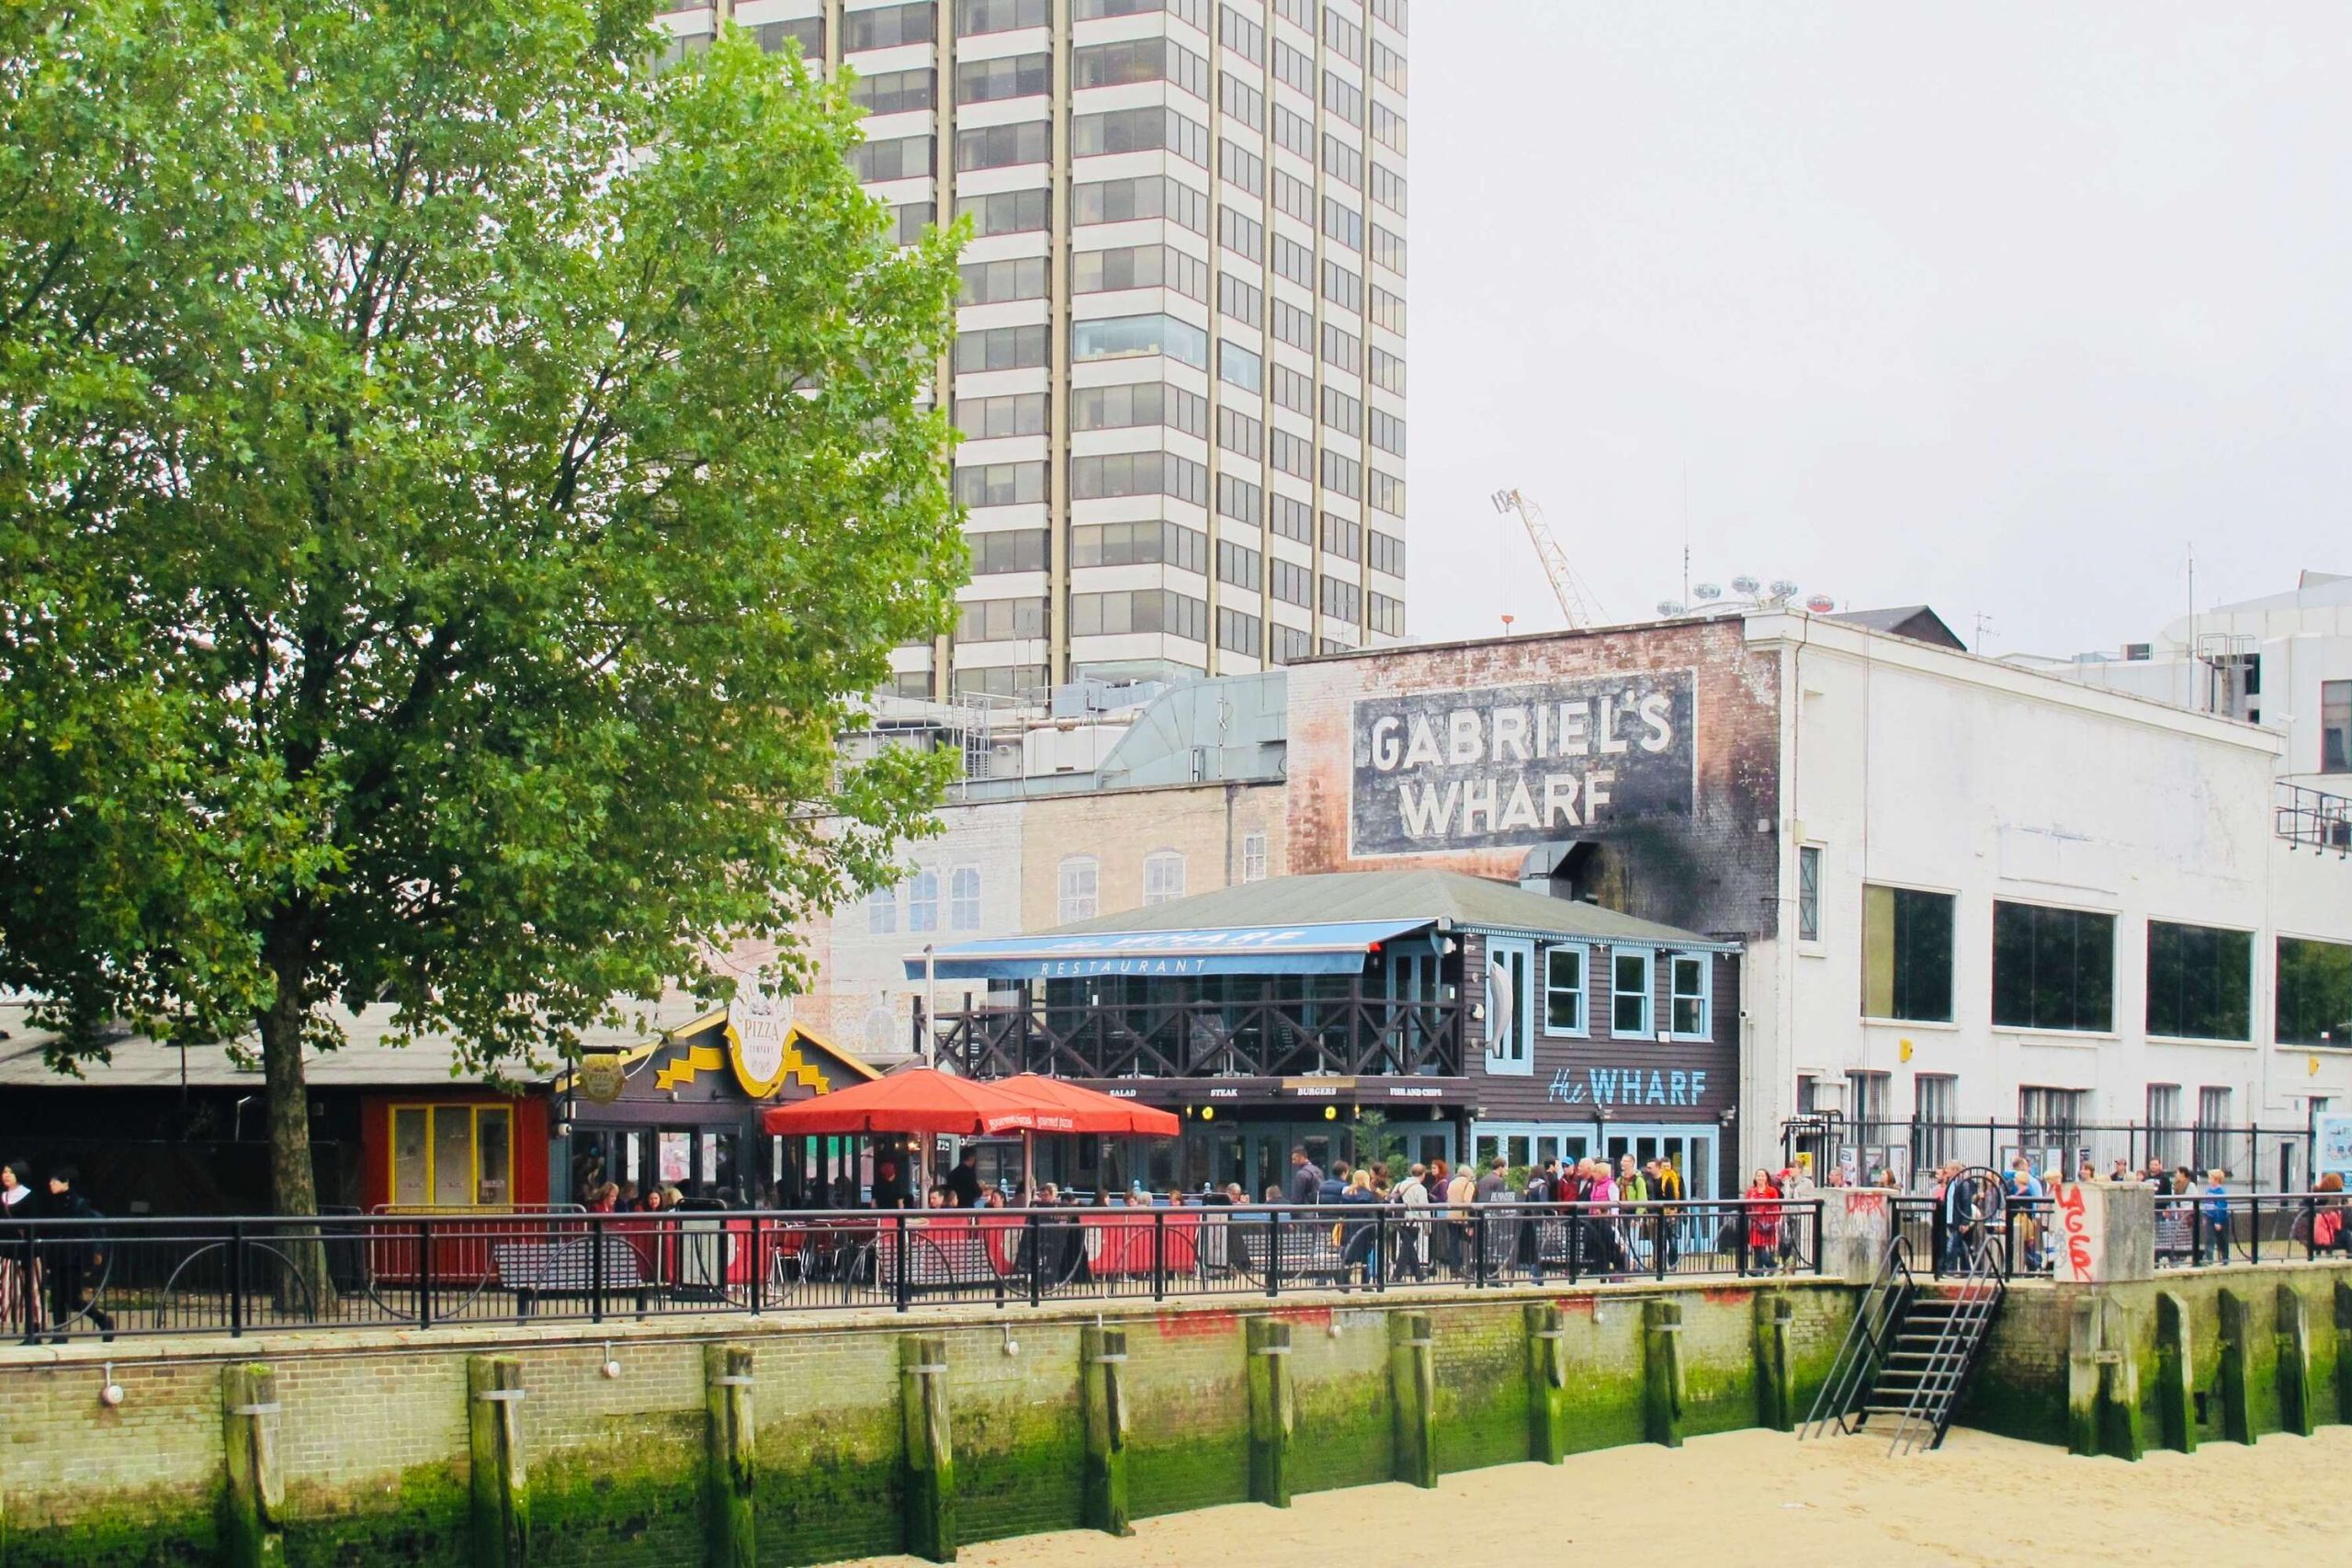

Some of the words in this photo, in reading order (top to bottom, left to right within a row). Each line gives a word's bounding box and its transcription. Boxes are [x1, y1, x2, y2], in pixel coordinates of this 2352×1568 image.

[1373, 690, 1672, 772] GABRIEL'S
[1398, 770, 1616, 838] WHARF
[1041, 959, 1206, 976] RESTAURANT
[744, 1019, 779, 1042] PIZZA
[1109, 1089, 1137, 1098] SALAD
[1210, 1089, 1238, 1097] STEAK
[1296, 1087, 1337, 1096] BURGERS
[1389, 1087, 1406, 1096] FISH
[1407, 1088, 1421, 1096] AND
[1421, 1088, 1442, 1097] CHIPS
[1589, 1068, 1706, 1105] WHARF
